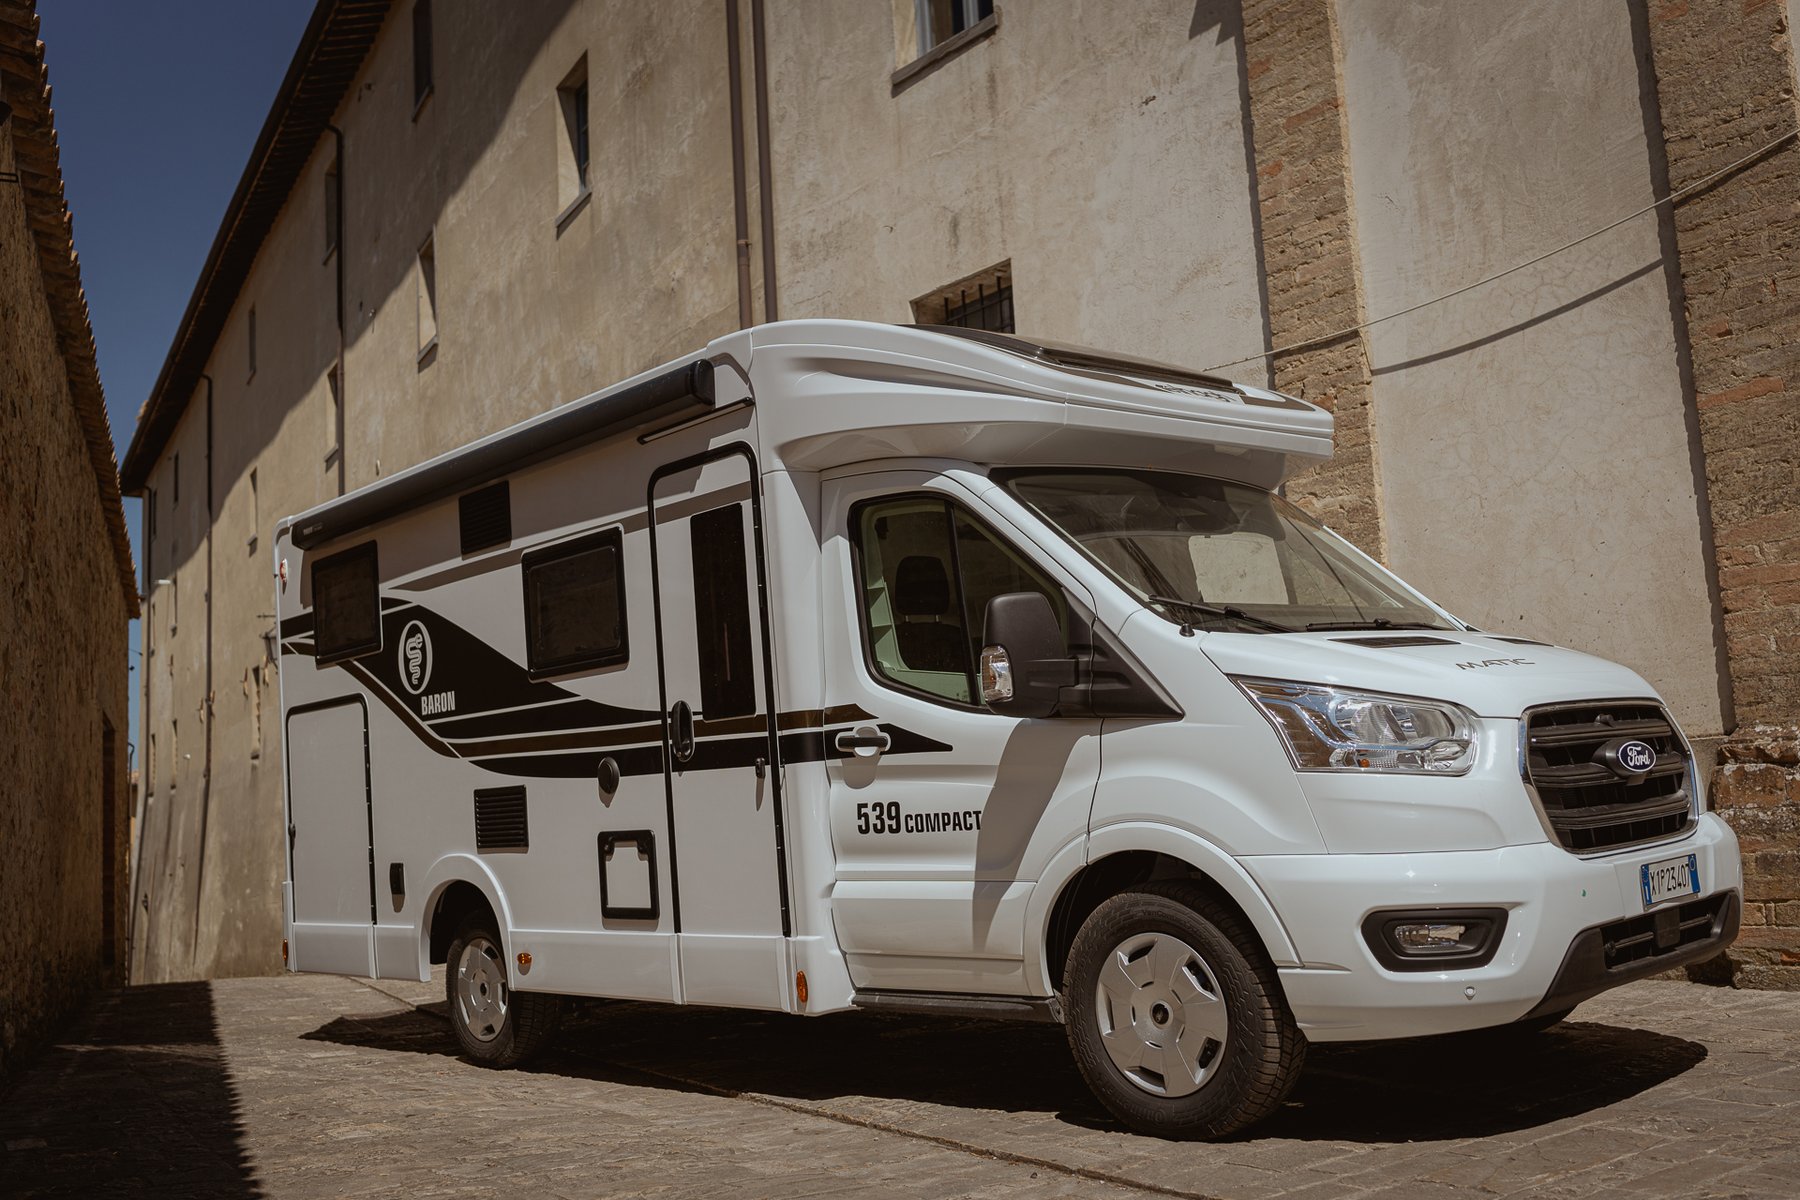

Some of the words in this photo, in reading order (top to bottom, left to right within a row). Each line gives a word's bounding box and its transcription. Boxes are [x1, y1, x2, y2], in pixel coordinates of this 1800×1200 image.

[1455, 658, 1535, 670] MATIC
[421, 690, 456, 716] BARON
[1627, 746, 1651, 767] Ford
[857, 801, 901, 835] 539
[904, 810, 982, 833] COMPACT
